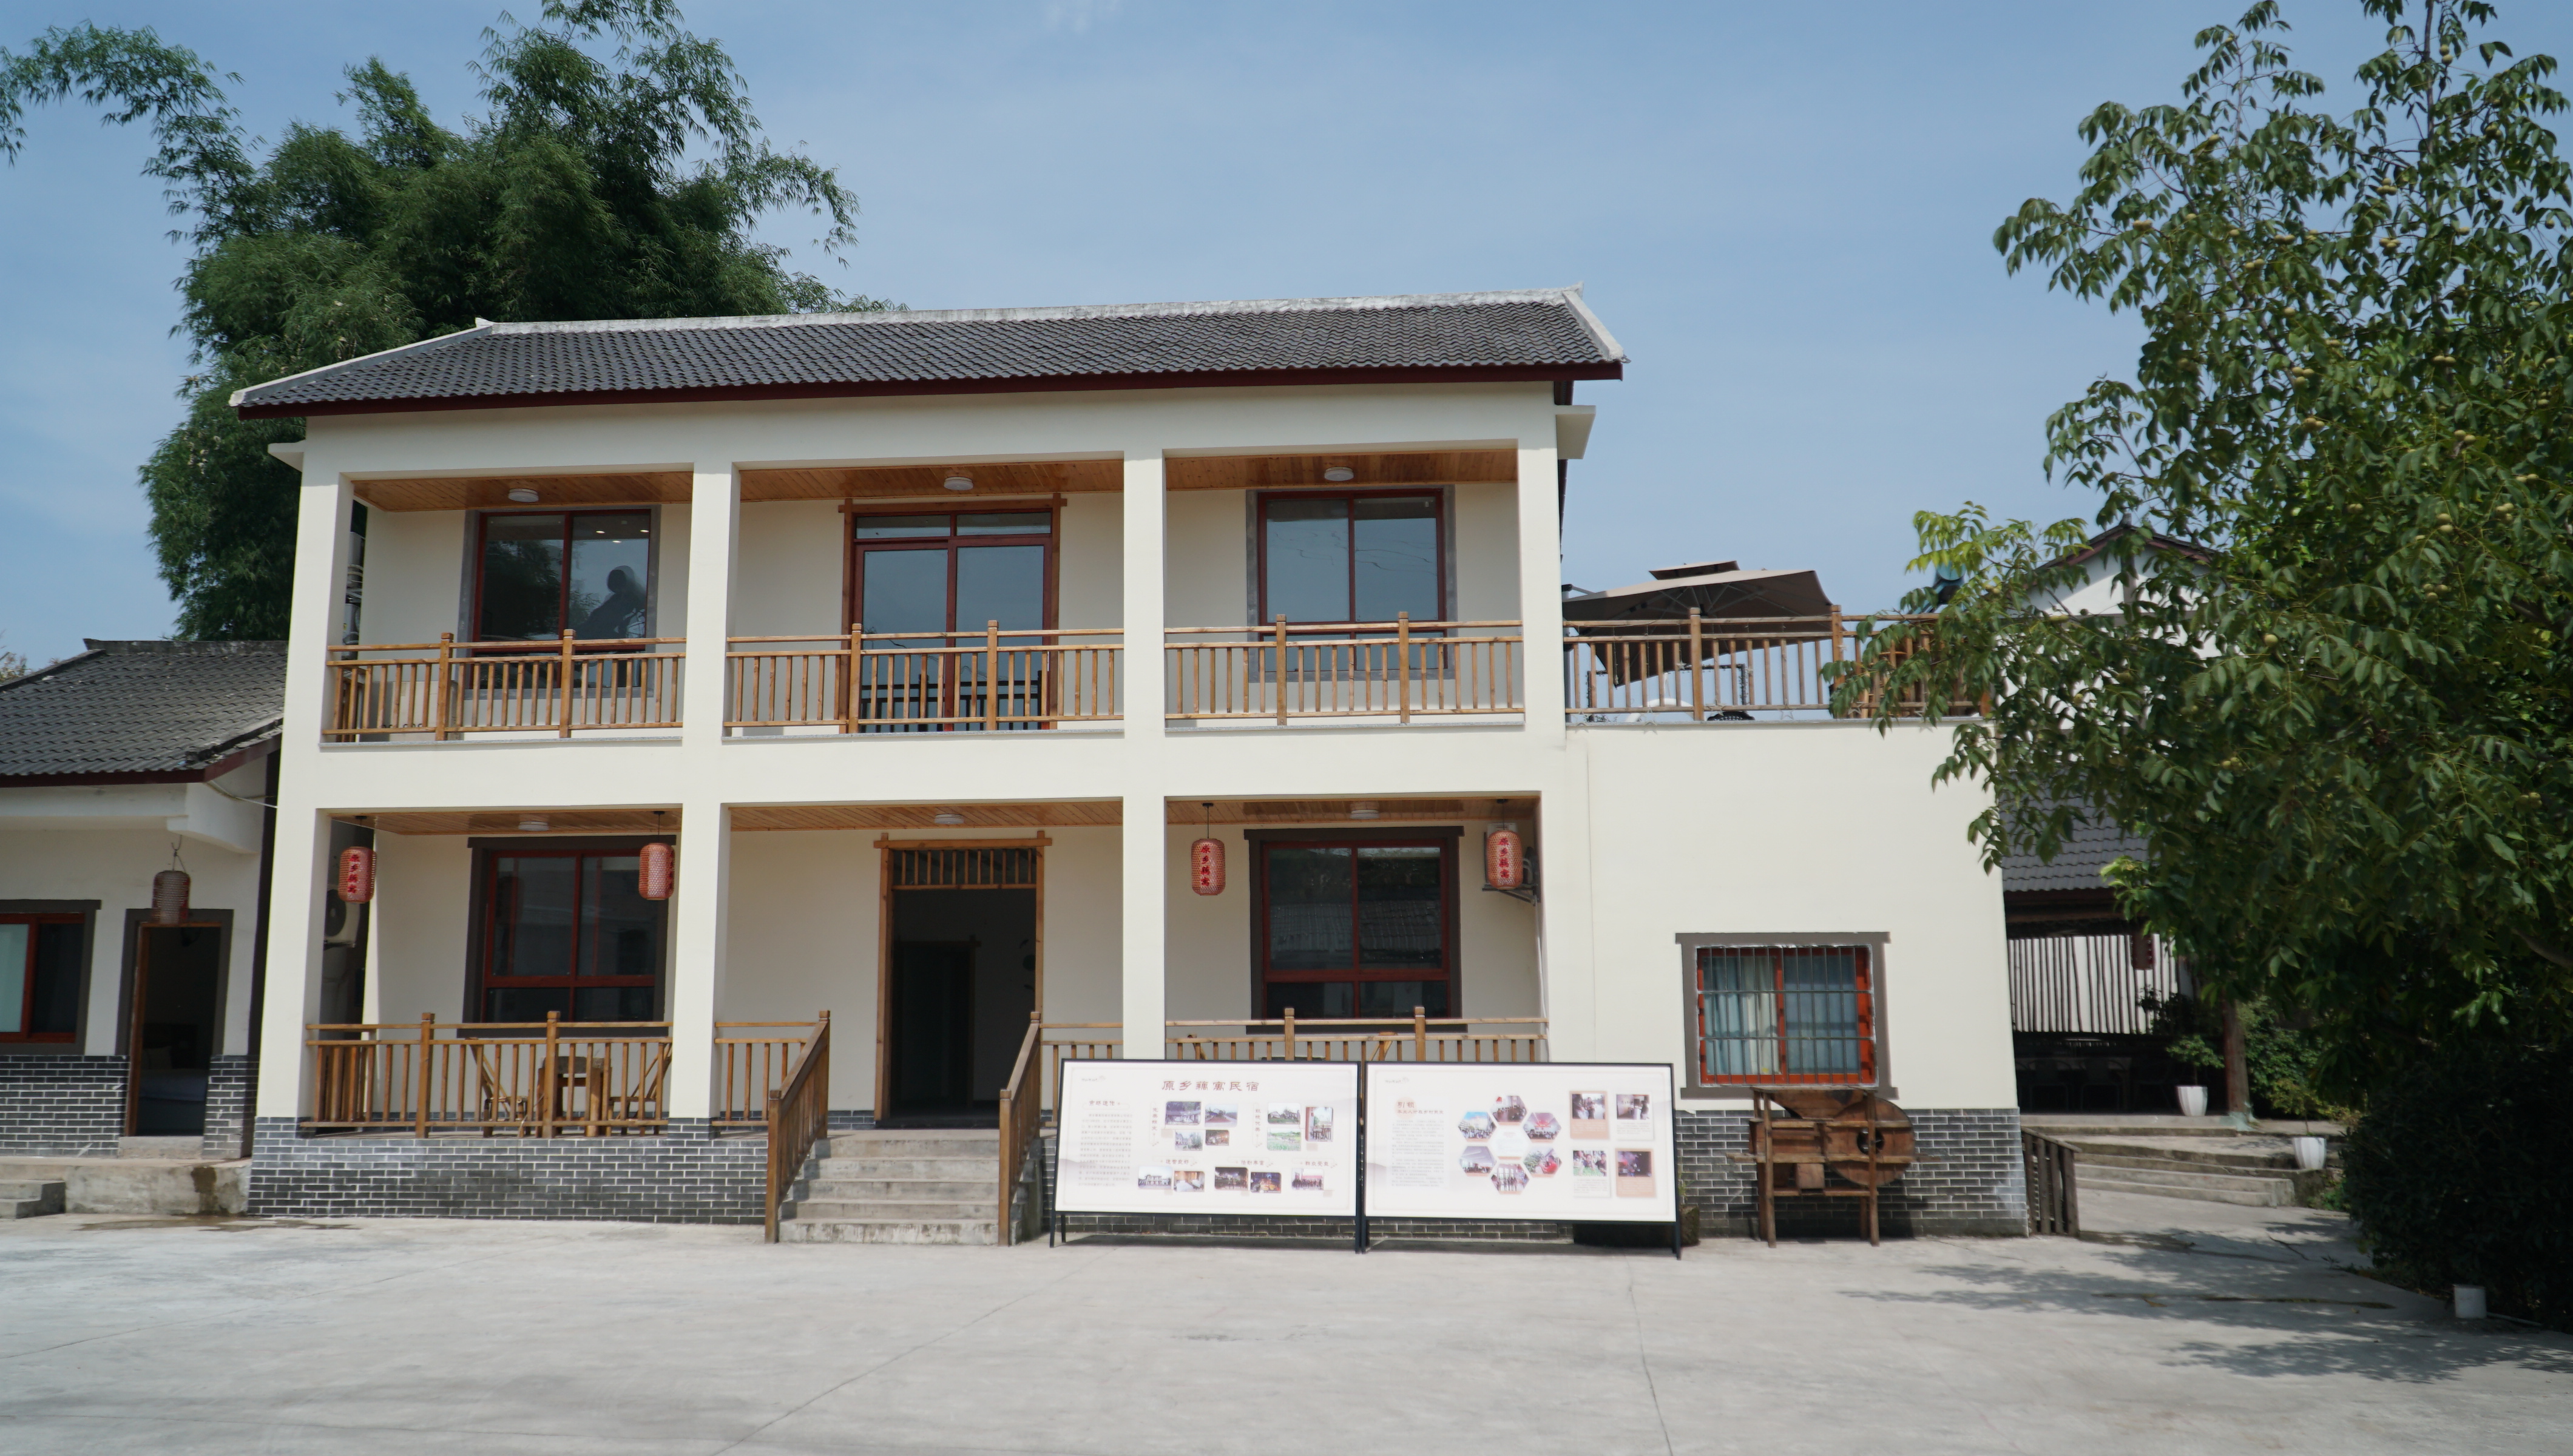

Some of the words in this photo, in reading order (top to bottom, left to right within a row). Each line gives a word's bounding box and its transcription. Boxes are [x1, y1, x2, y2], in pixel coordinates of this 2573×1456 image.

[1161, 1080, 1259, 1091] 原乡藕寓民宿
